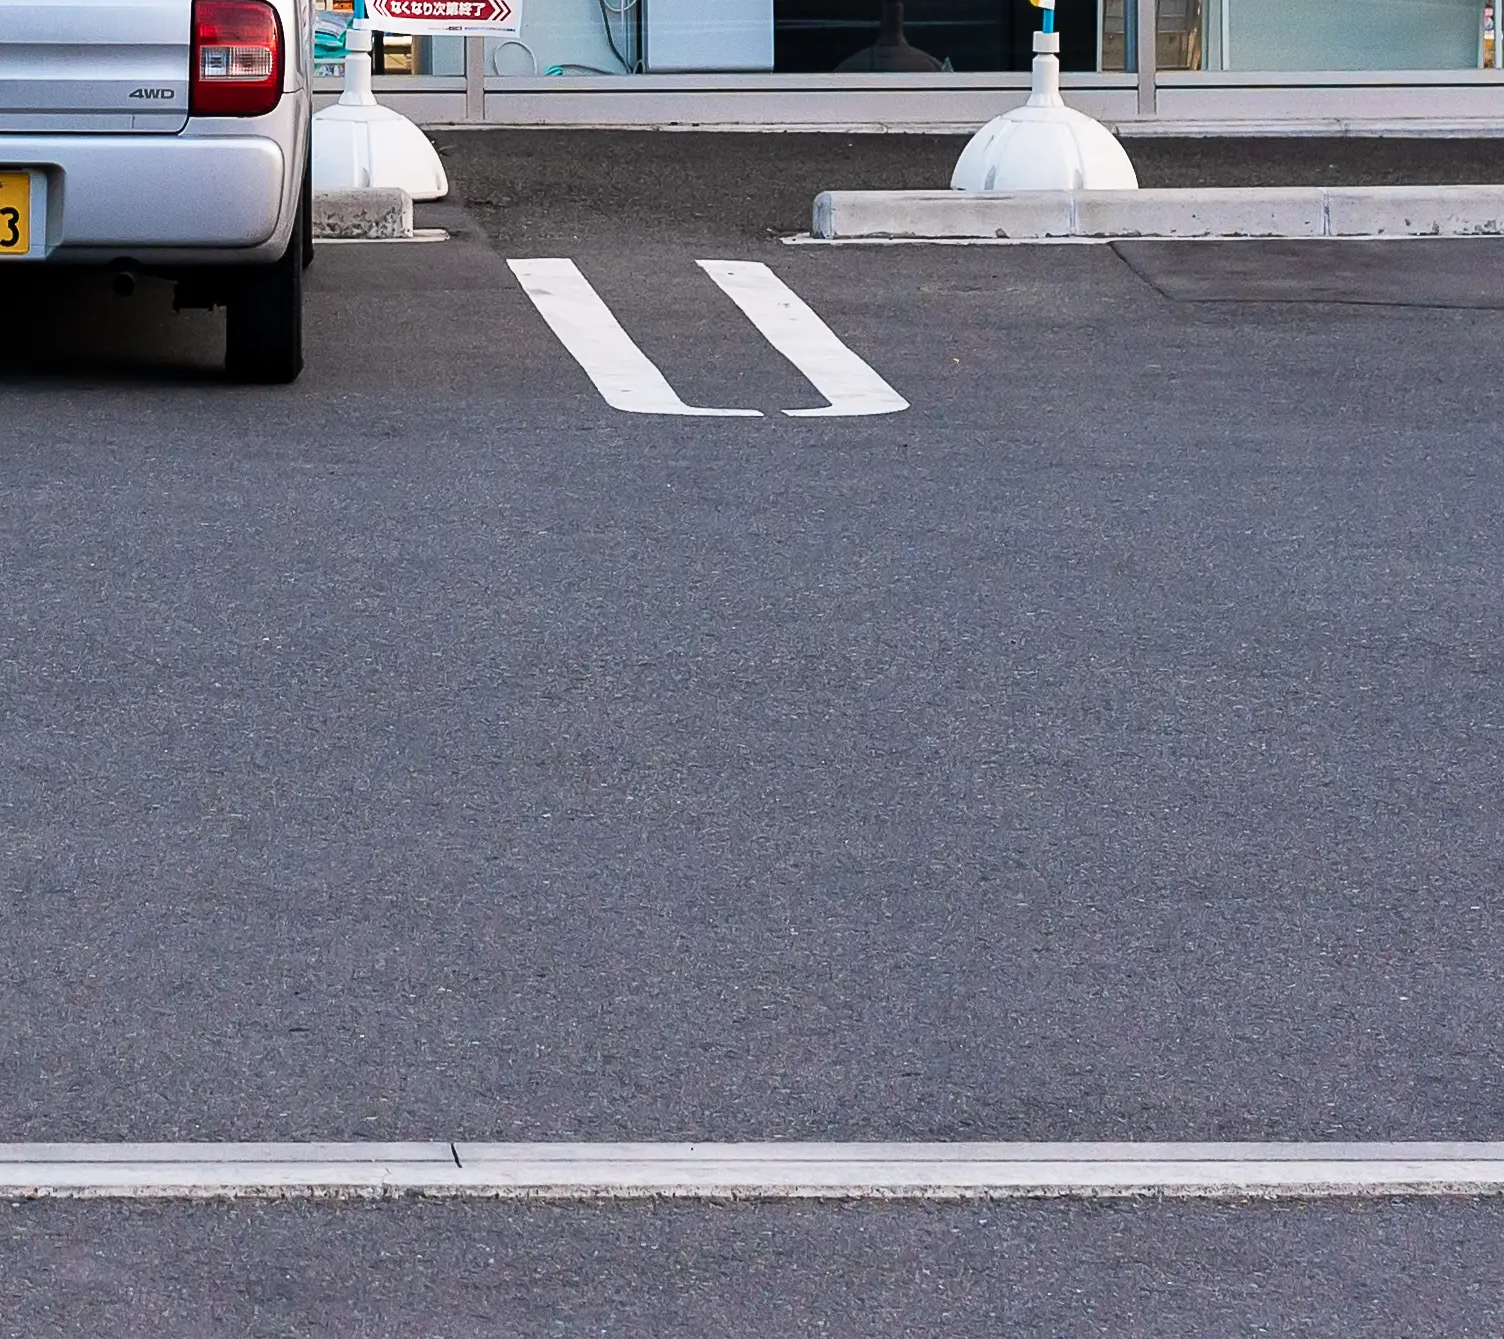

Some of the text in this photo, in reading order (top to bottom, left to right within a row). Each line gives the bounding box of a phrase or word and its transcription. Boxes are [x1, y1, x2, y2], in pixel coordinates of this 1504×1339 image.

[389, 0, 487, 18] なくなり次第終了
[128, 88, 175, 100] 4WD
